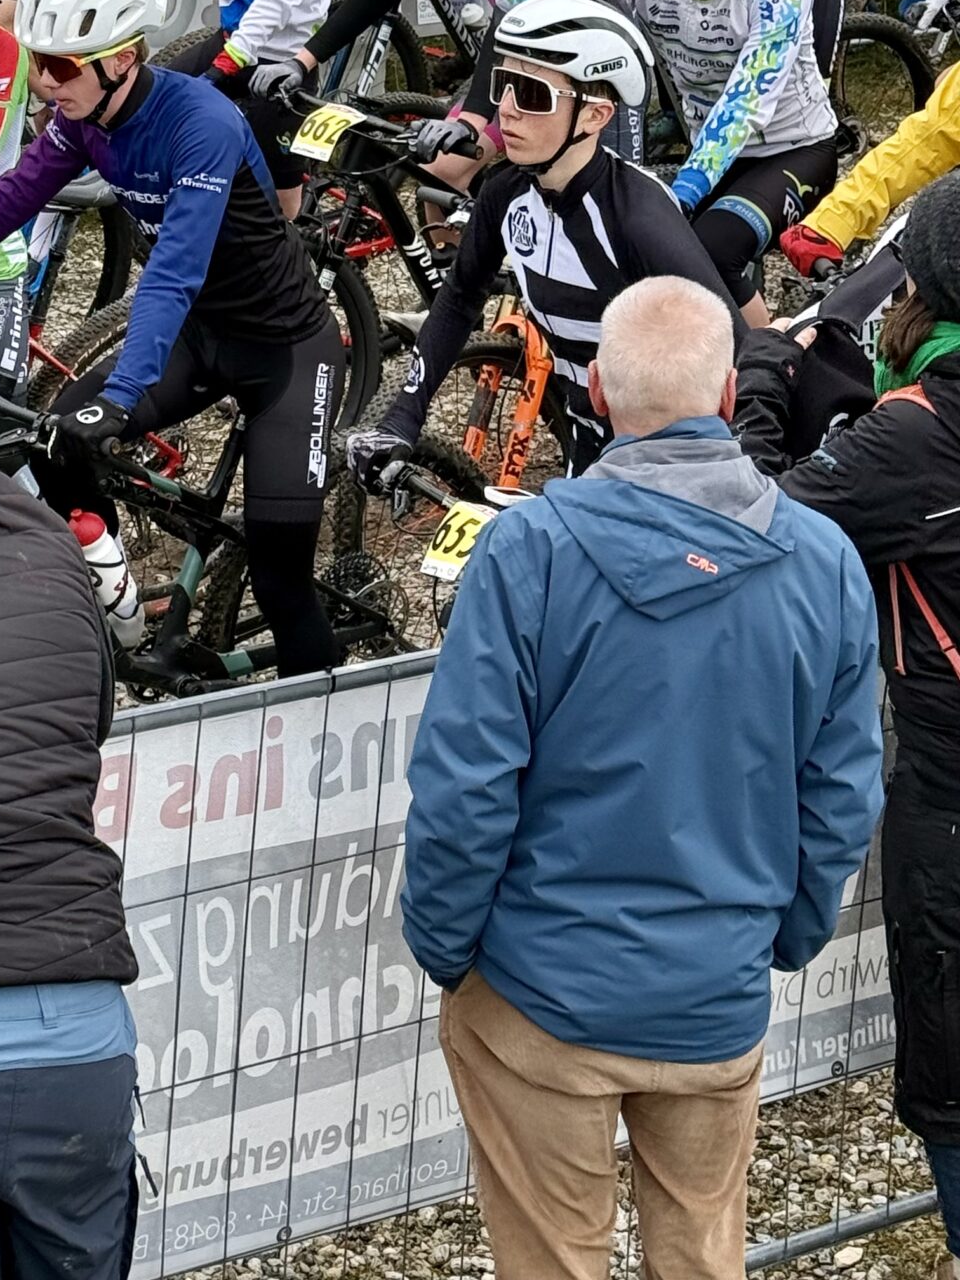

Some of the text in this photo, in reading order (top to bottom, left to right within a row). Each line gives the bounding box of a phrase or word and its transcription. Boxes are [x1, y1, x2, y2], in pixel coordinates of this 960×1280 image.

[590, 59, 624, 76] ABUS
[299, 111, 351, 146] 662
[308, 363, 330, 463] BOLLINGER
[504, 433, 530, 477] FOX
[686, 553, 719, 575] CMP
